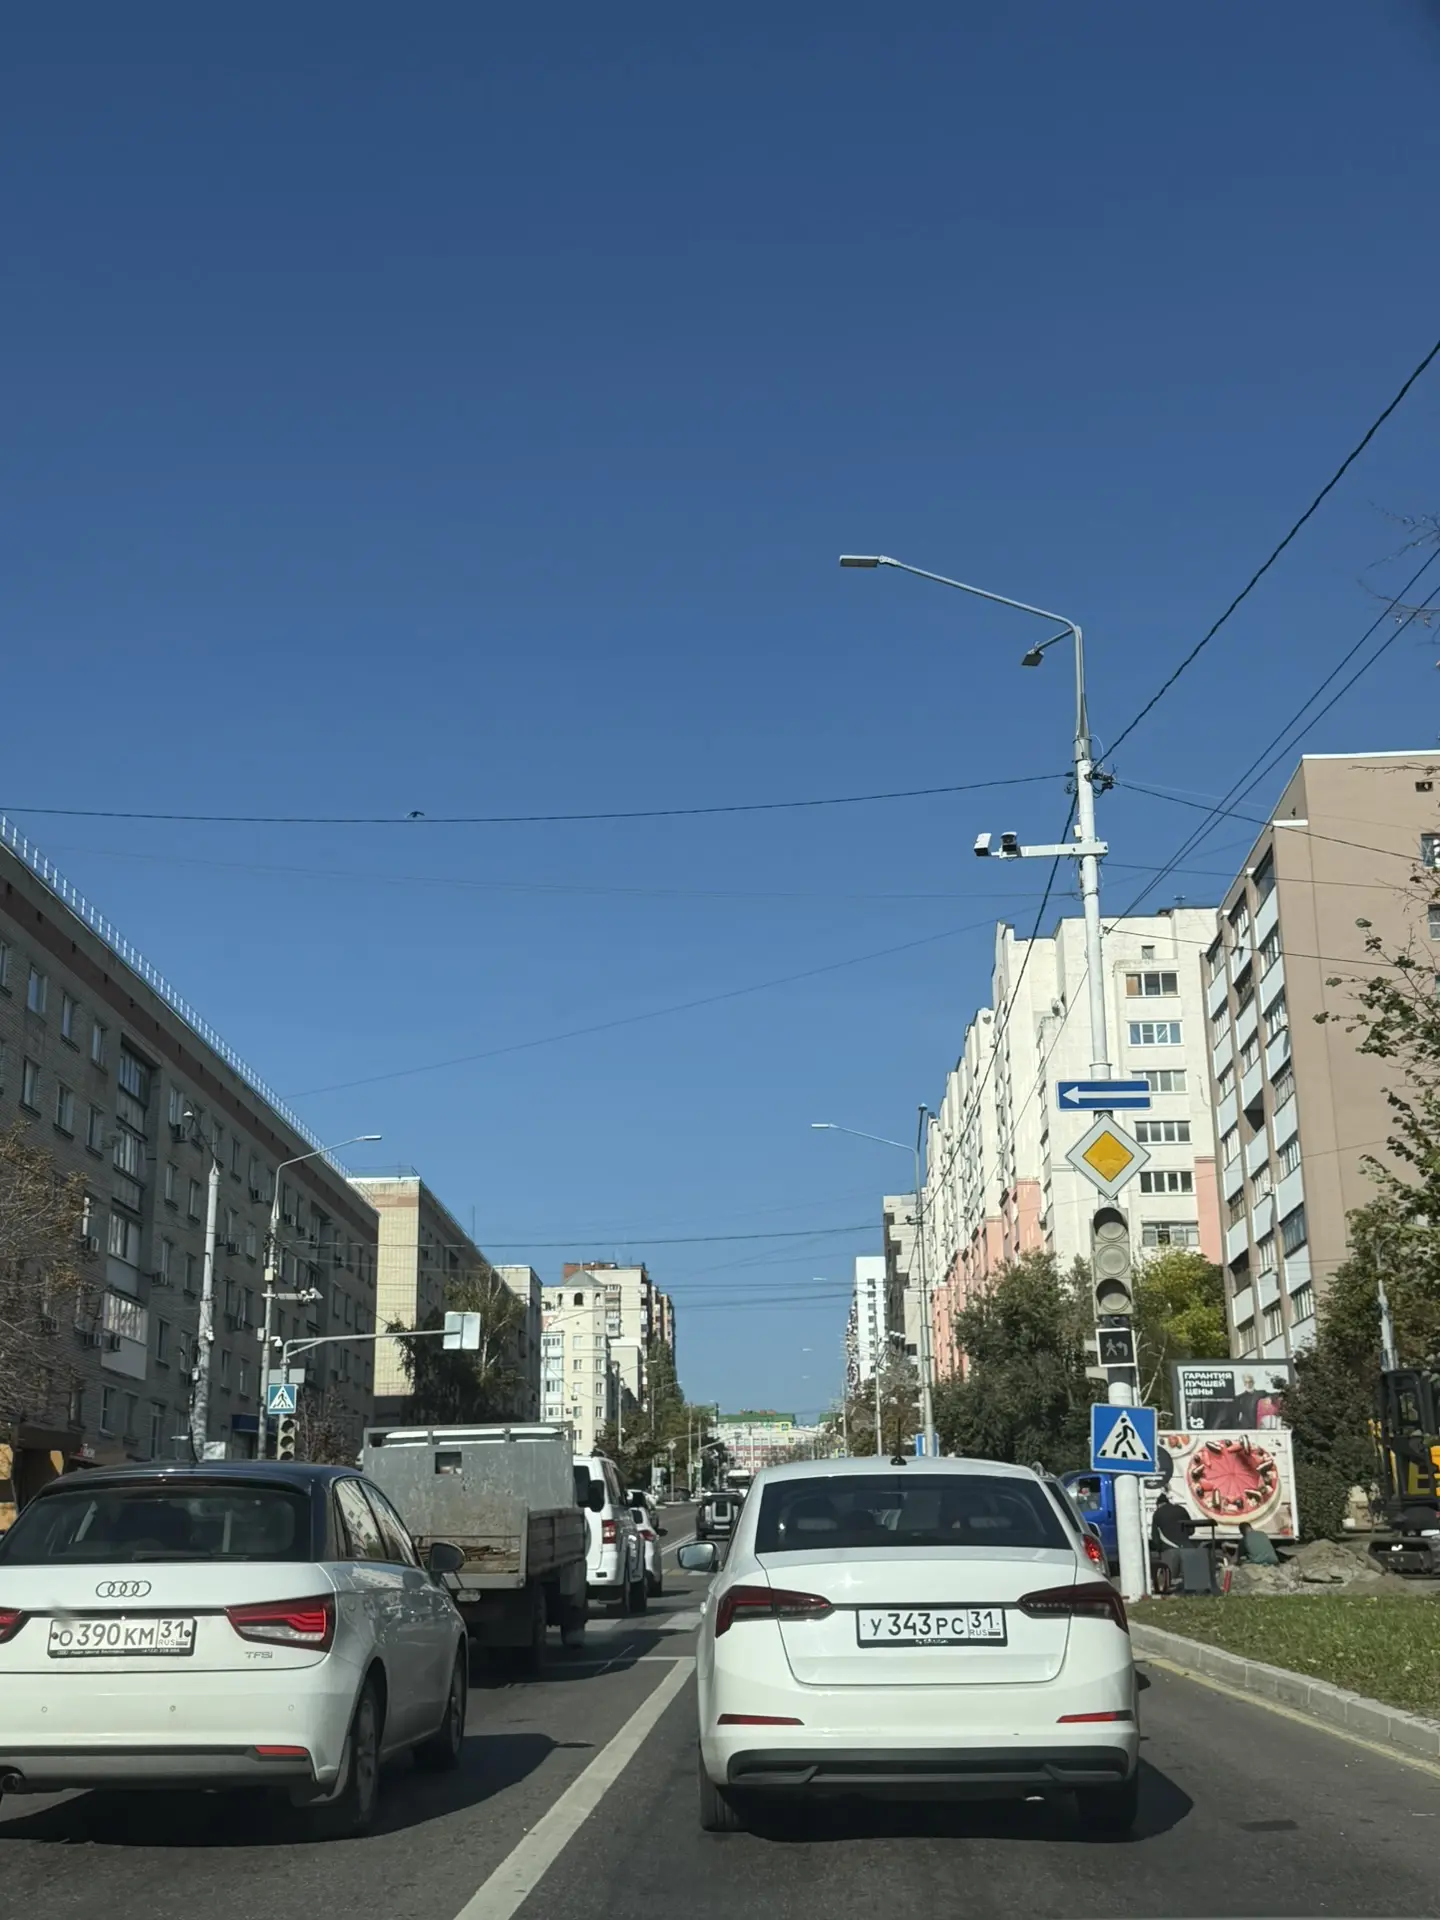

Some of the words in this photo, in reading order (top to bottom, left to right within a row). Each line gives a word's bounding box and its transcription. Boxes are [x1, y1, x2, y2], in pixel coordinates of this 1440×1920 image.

[1185, 1379, 1226, 1387] ЛУЧШЕЙ
[1185, 1388, 1213, 1396] ЦЕНЫ
[1190, 1416, 1204, 1429] t2
[970, 1611, 993, 1628] 31
[161, 1621, 184, 1638] 31
